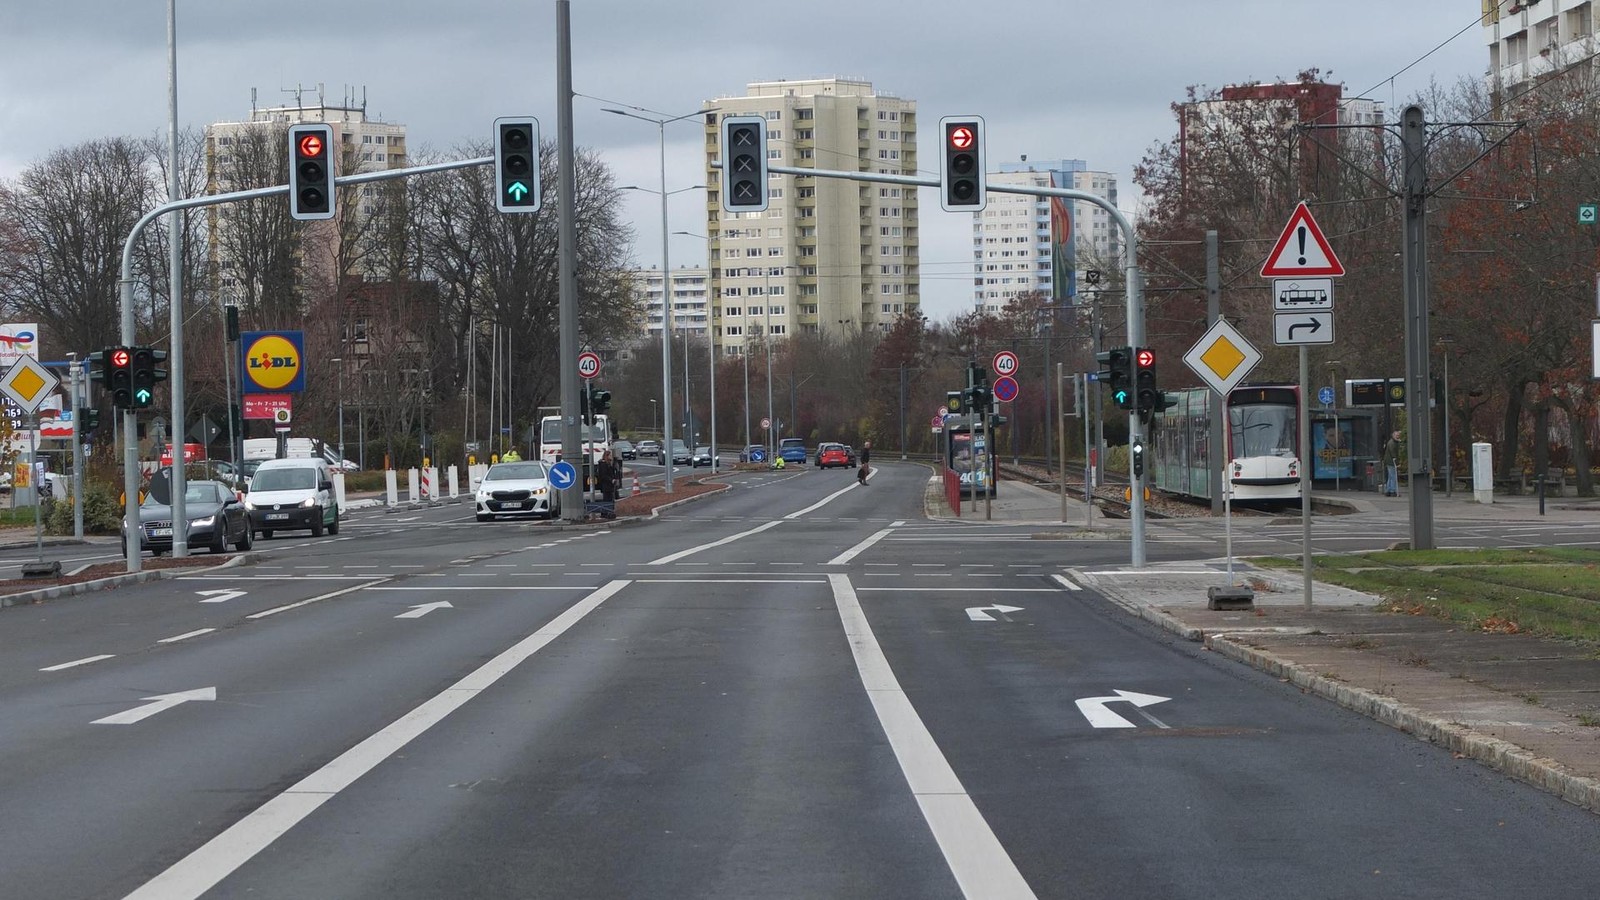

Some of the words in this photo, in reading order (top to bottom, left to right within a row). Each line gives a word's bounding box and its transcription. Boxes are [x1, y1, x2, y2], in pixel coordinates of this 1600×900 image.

[581, 359, 596, 371] 40
[998, 358, 1013, 370] 40
[1260, 390, 1265, 401] 1
